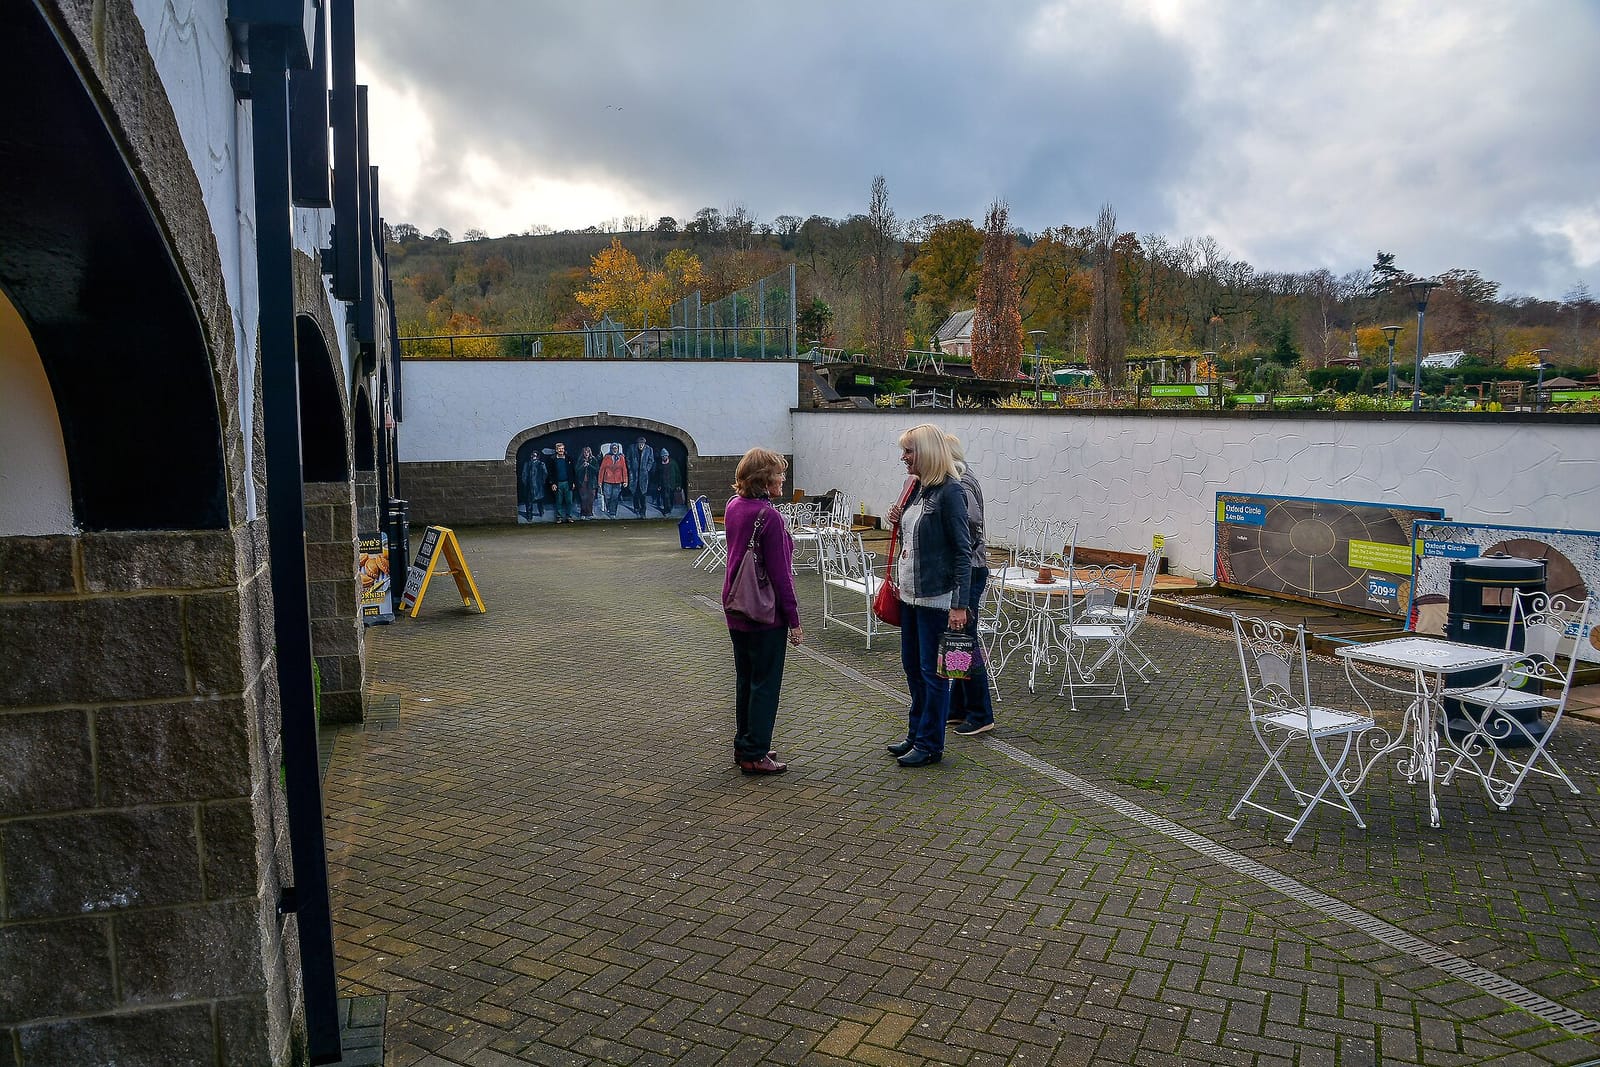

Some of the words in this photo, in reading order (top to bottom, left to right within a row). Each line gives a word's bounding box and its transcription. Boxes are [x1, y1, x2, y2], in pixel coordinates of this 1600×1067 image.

[1226, 505, 1244, 513] Oxford
[1244, 506, 1261, 514] Circle
[1424, 542, 1446, 550] Oxford
[406, 580, 421, 593] OPEN
